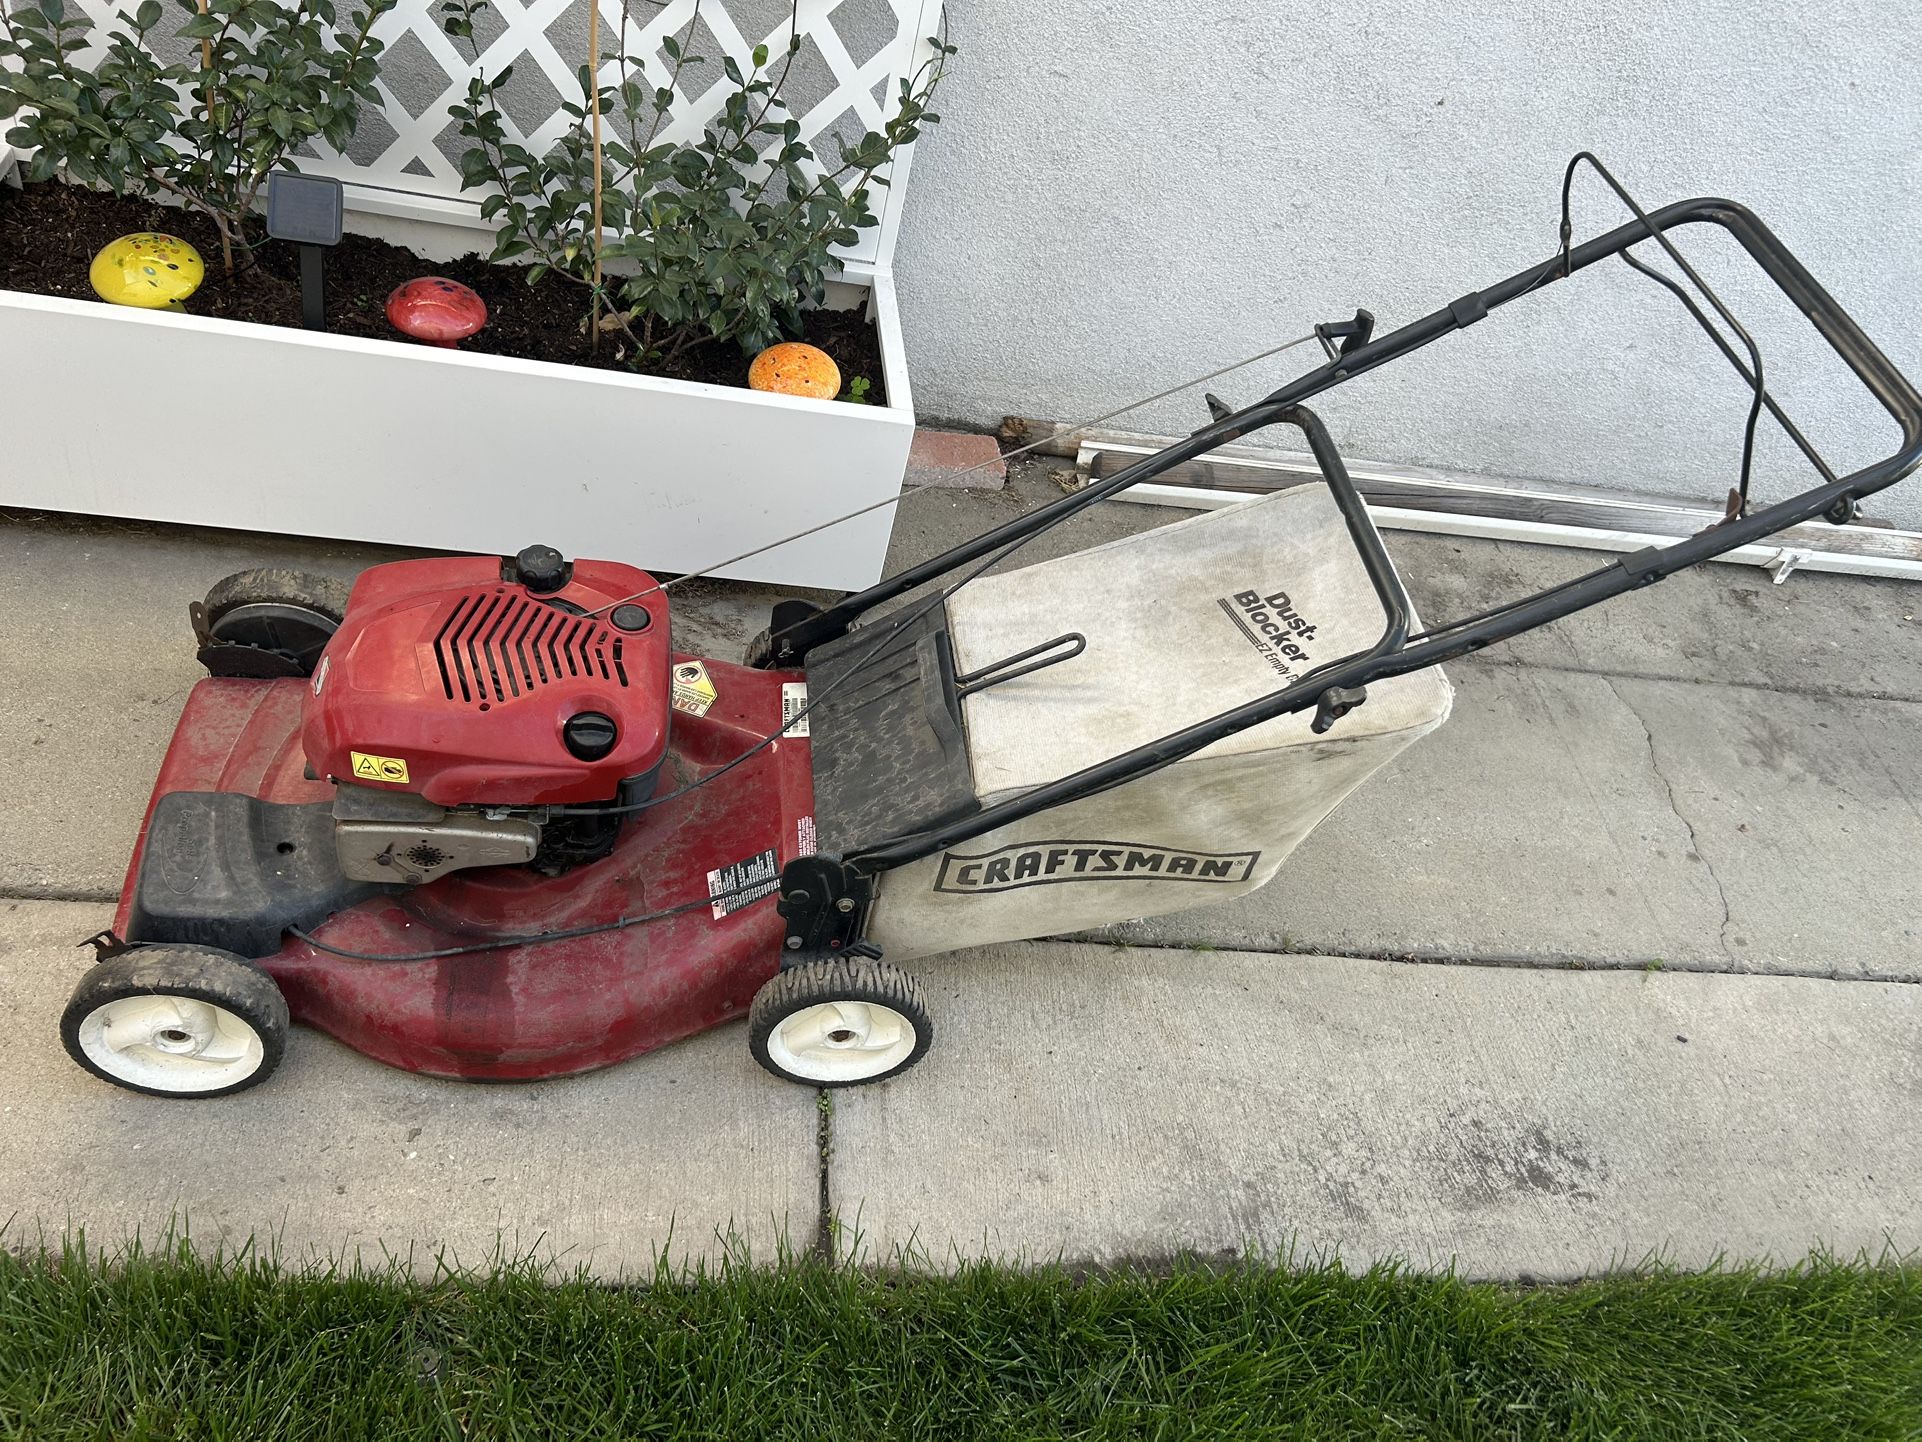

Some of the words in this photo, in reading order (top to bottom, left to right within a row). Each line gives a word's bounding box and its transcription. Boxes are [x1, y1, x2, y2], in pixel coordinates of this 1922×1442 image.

[1233, 589, 1310, 662] Blocker
[1264, 591, 1317, 641] Dust-
[1255, 642, 1272, 654] EZ
[1264, 652, 1291, 675] Empty
